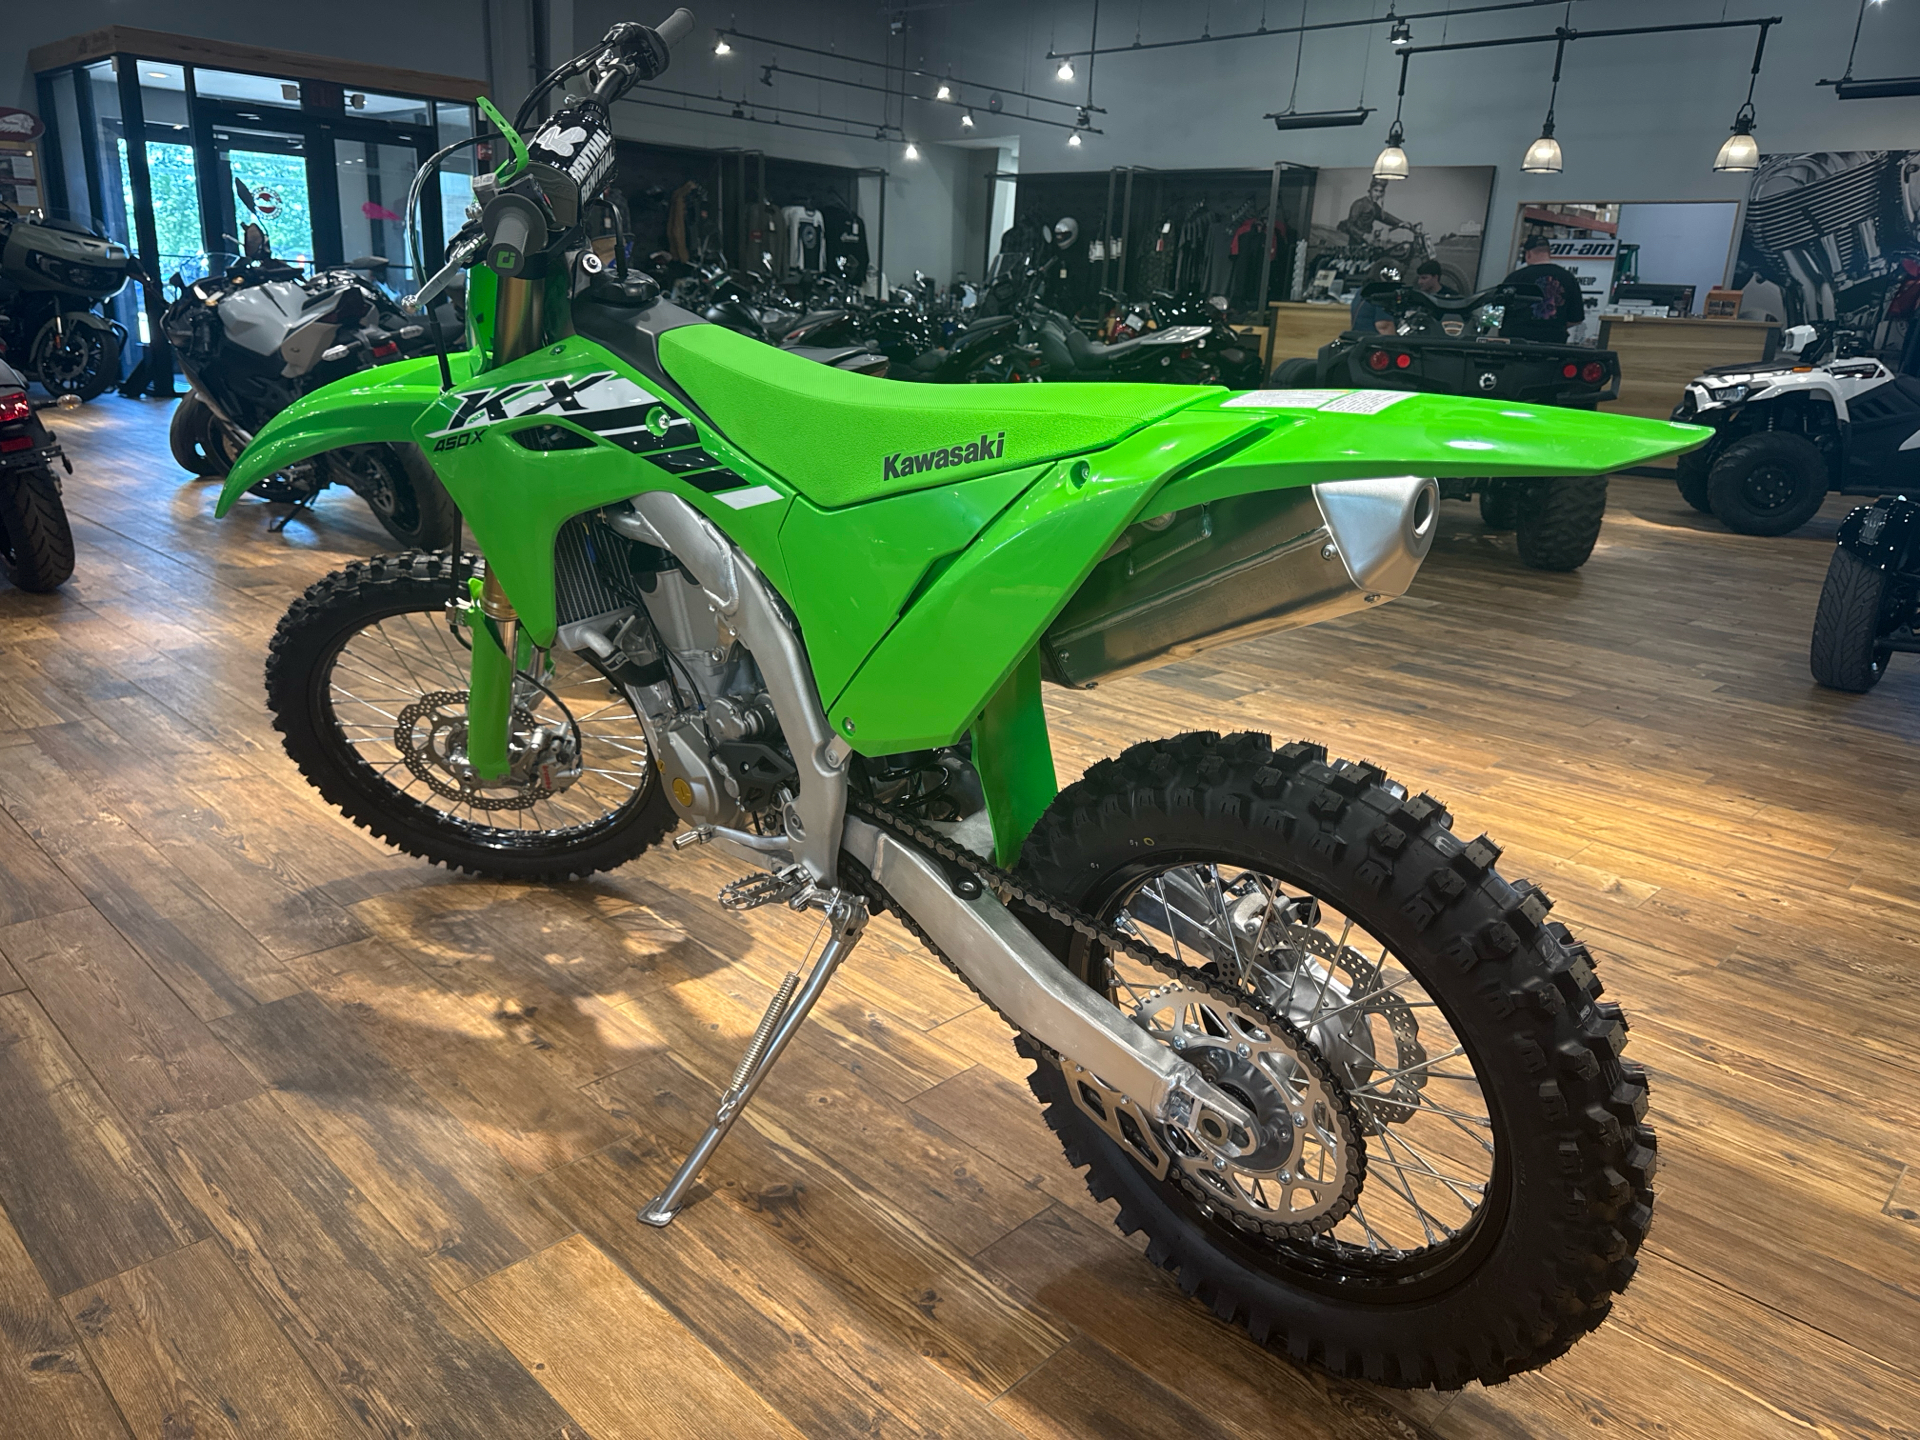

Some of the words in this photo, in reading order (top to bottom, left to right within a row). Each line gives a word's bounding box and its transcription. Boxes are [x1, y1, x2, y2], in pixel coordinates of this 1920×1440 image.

[568, 129, 612, 186] RENTHAL
[581, 145, 615, 205] RENTHAL
[1549, 243, 1615, 255] an-am
[448, 371, 617, 431] KX
[883, 432, 1005, 481] Kawasaki
